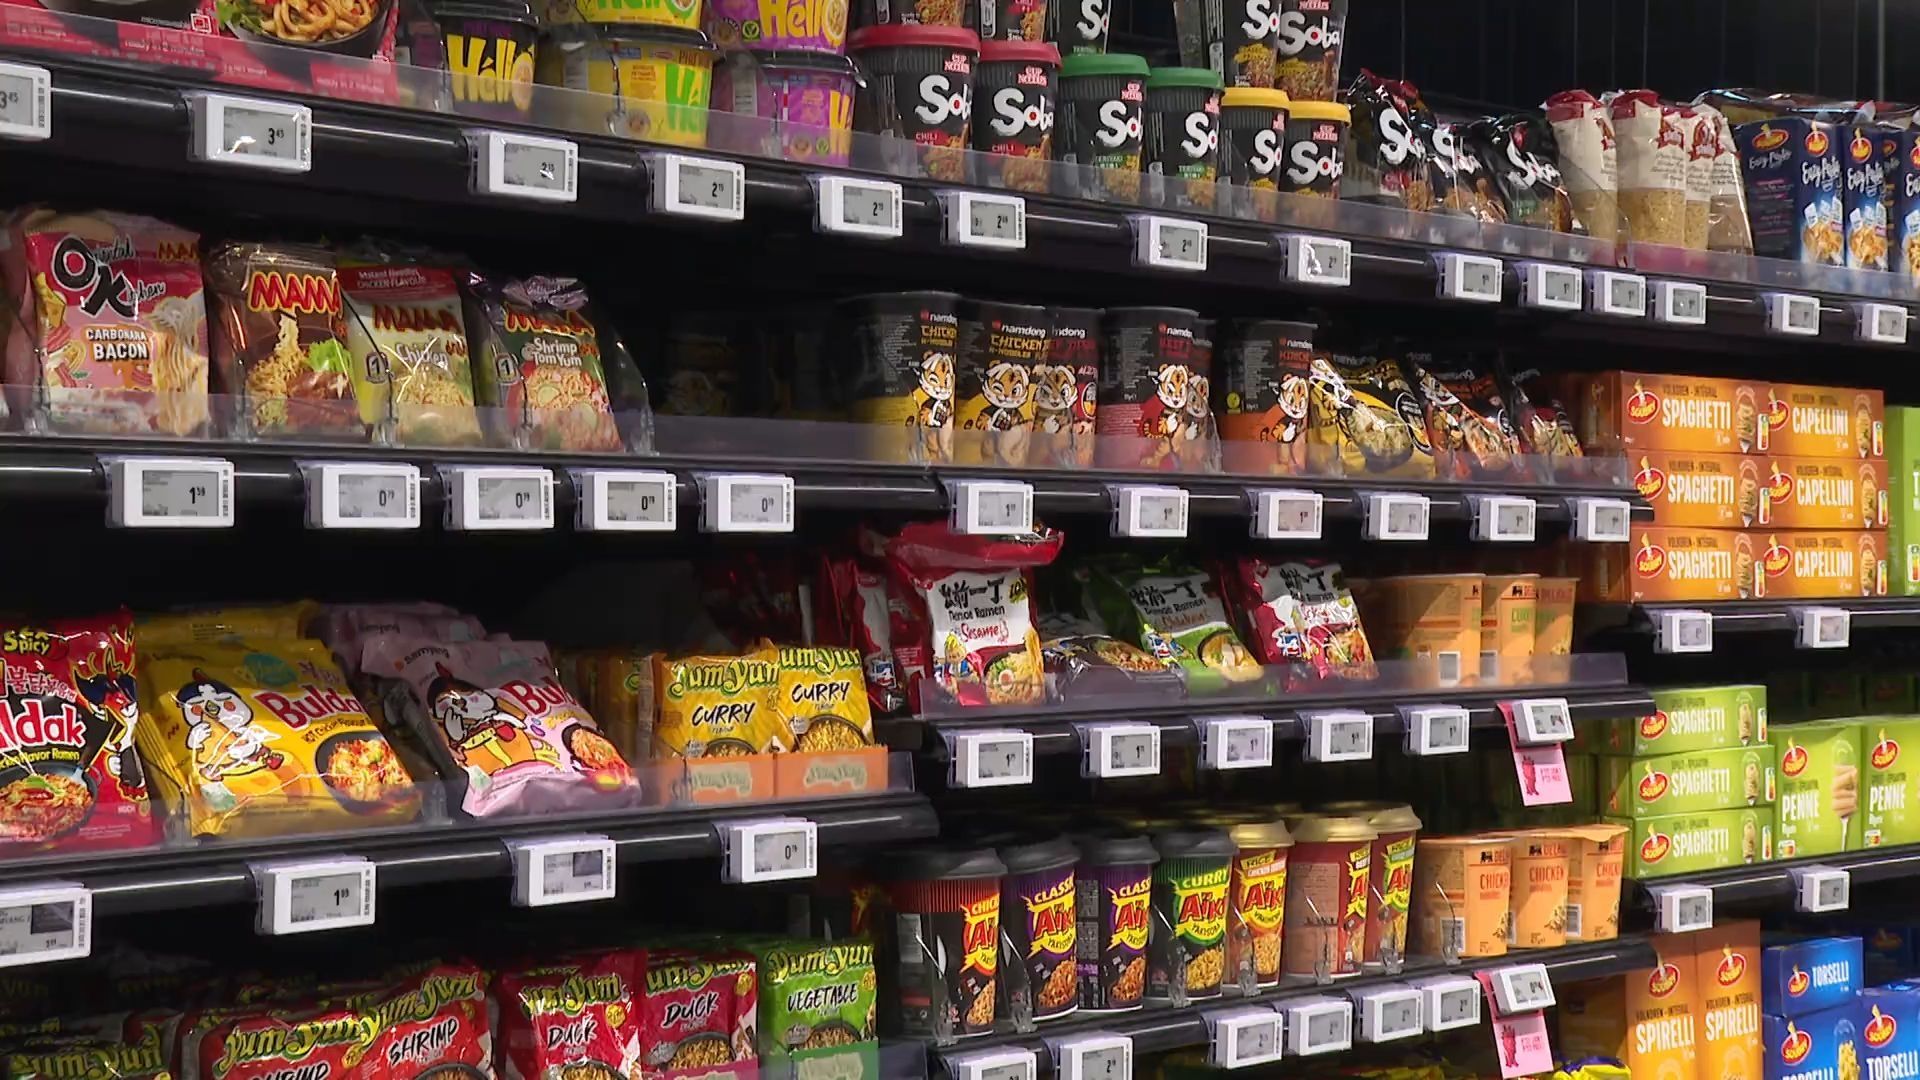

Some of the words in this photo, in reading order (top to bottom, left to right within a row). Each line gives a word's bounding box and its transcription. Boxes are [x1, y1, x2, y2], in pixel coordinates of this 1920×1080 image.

[85, 328, 147, 342] CARBONARA
[1001, 323, 1047, 338] namdong
[92, 342, 148, 361] BACON
[532, 352, 558, 367] Tom
[558, 356, 583, 368] Yum
[533, 337, 578, 355] Shrimp
[1662, 398, 1731, 430] SPAGHETTI
[1792, 407, 1848, 436] CAPELLINI
[1668, 474, 1734, 505] SPAGHETTI
[1796, 478, 1854, 506] CAPELLINI
[1668, 550, 1731, 580] SPAGHETTI
[1794, 551, 1853, 578] CAPELLINI
[976, 604, 1006, 618] Ramen
[3, 630, 50, 653] Spicy
[961, 621, 1000, 643] Sesame
[1671, 707, 1725, 736] SPAGHETTI
[1671, 767, 1731, 798] SPAGHETTI
[1781, 793, 1820, 822] PENNE
[1869, 783, 1907, 813] PENNE
[1672, 828, 1729, 858] SPAGHETTI
[1181, 868, 1228, 889] CURRY
[1529, 866, 1564, 883] CHICKEN
[1811, 960, 1849, 988] TORSELLI
[661, 993, 719, 1028] DUCK
[787, 984, 858, 1013] VEGETABLE
[1636, 1014, 1695, 1055] SPIRELLI
[1705, 1003, 1758, 1044] SPIRELLI
[388, 1017, 458, 1068] SHRIMP
[1866, 1050, 1920, 1080] TORSELLI
